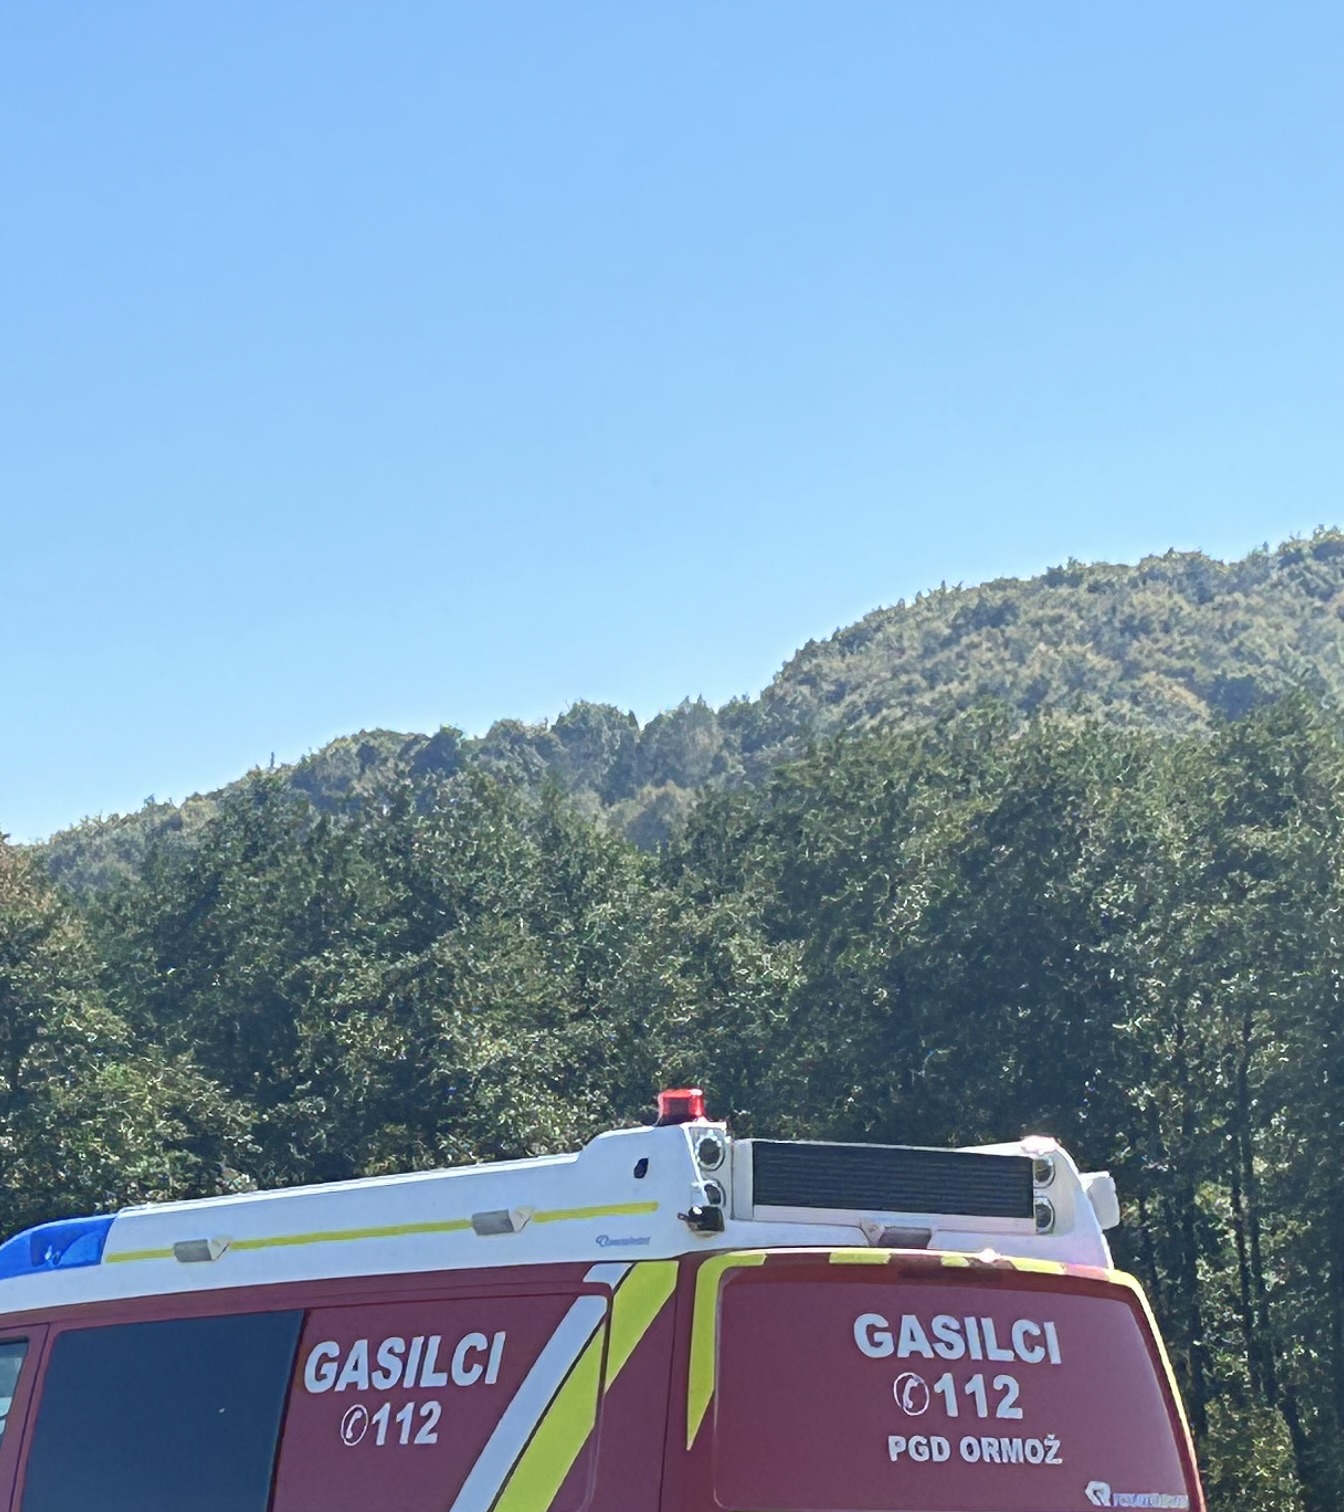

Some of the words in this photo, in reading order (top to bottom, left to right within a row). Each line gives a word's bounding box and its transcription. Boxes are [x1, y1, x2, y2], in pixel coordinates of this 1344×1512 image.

[304, 1330, 506, 1394] GASILCI
[853, 1312, 1062, 1365] GASILCI
[933, 1372, 1024, 1420] 112
[371, 1400, 442, 1446] 112
[887, 1435, 951, 1462] PGD
[959, 1433, 1063, 1465] ORMOŽ
